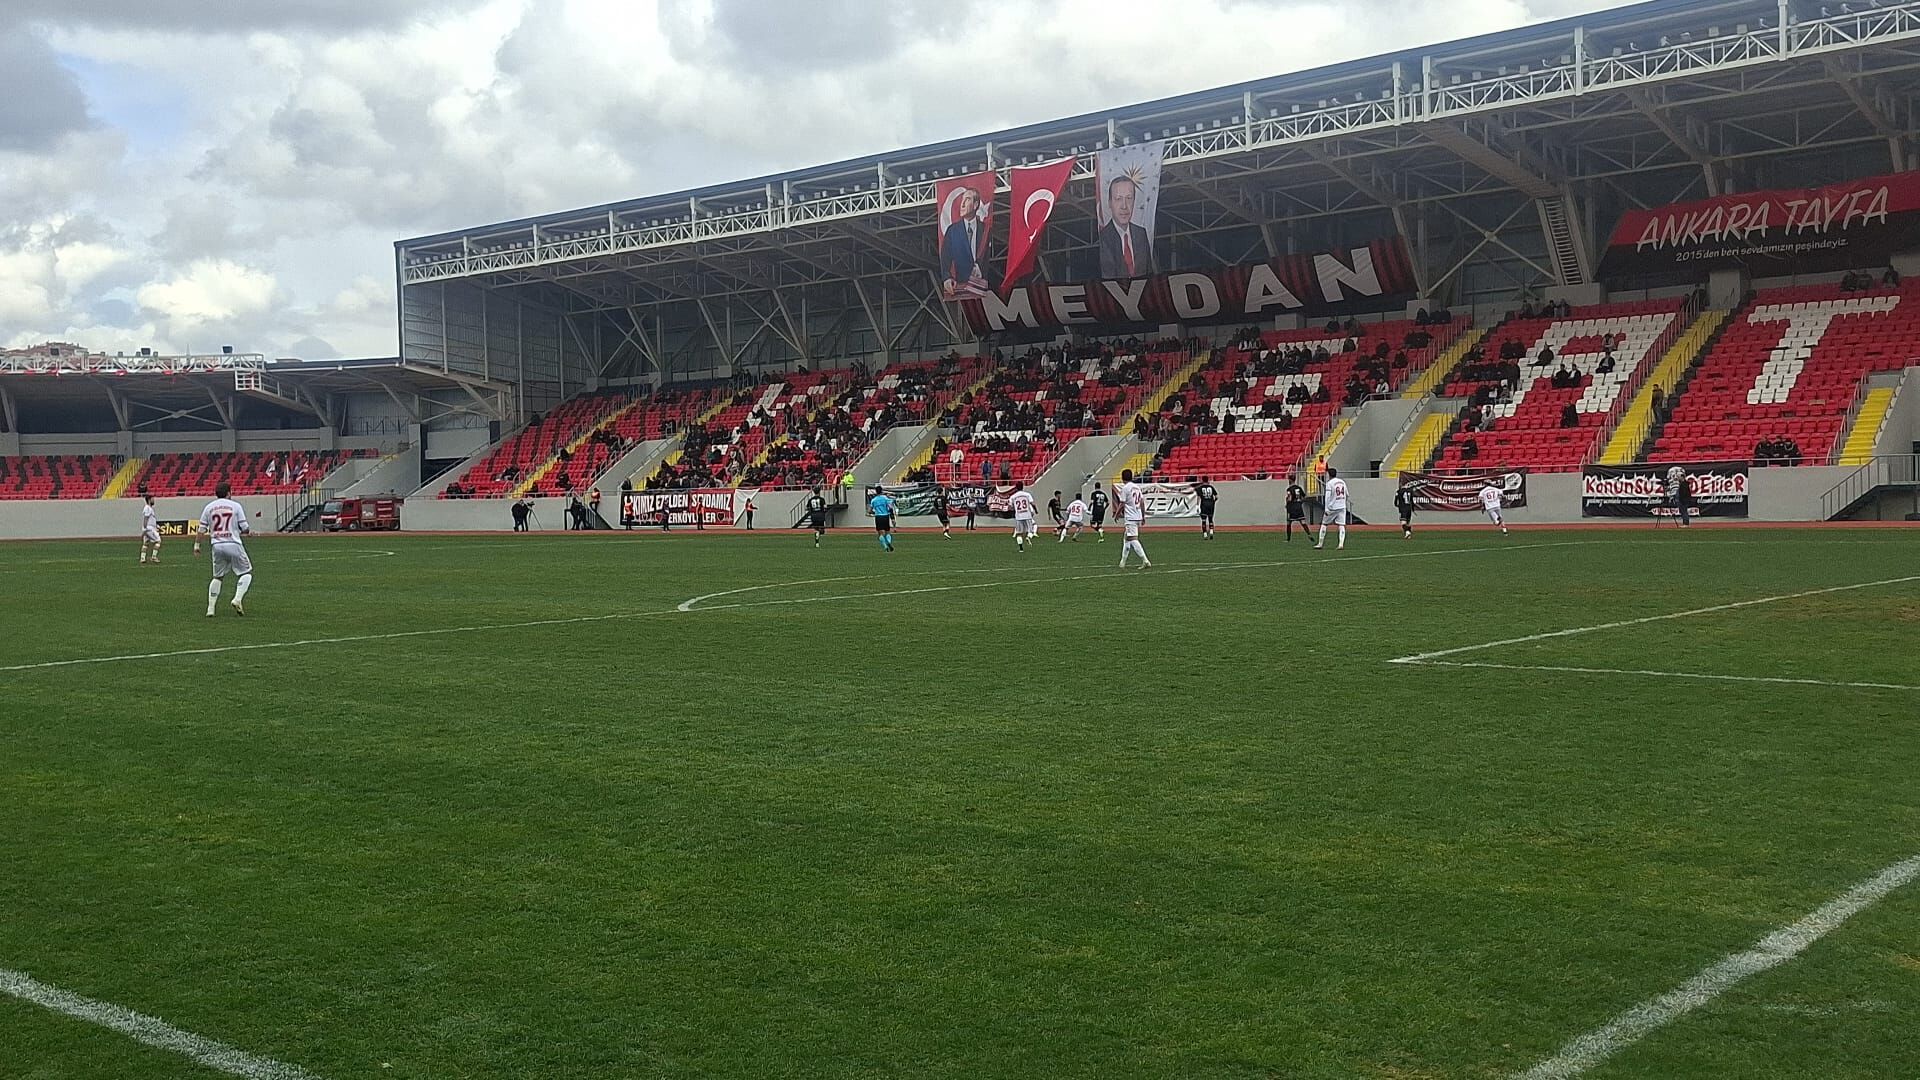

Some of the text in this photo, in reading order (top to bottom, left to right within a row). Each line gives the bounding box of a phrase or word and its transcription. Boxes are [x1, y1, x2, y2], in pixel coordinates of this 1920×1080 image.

[1637, 186, 1889, 253] ANKARA TAYFA
[1721, 246, 1739, 258] beri
[984, 247, 1383, 331] MEYDAN
[623, 495, 655, 519] AKIMIZ
[1015, 499, 1028, 510] 23
[211, 512, 233, 532] 27
[663, 510, 716, 524] ERKÖYLLER
